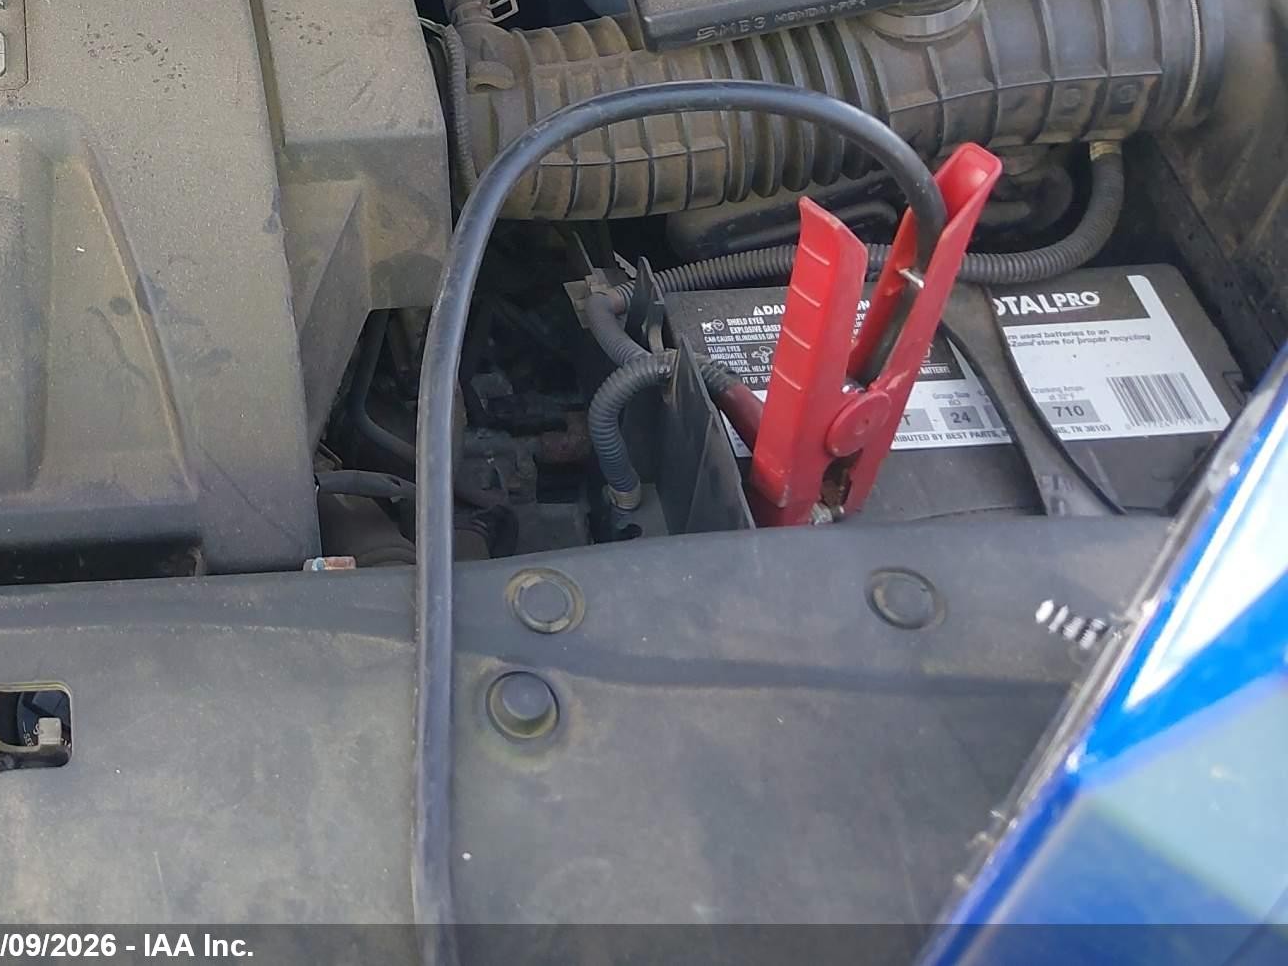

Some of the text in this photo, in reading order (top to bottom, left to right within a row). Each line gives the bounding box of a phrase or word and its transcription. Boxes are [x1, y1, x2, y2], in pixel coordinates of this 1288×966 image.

[992, 291, 1100, 316] OTALPRO
[950, 411, 971, 424] 24
[1052, 405, 1085, 418] 710
[947, 431, 967, 440] BEST
